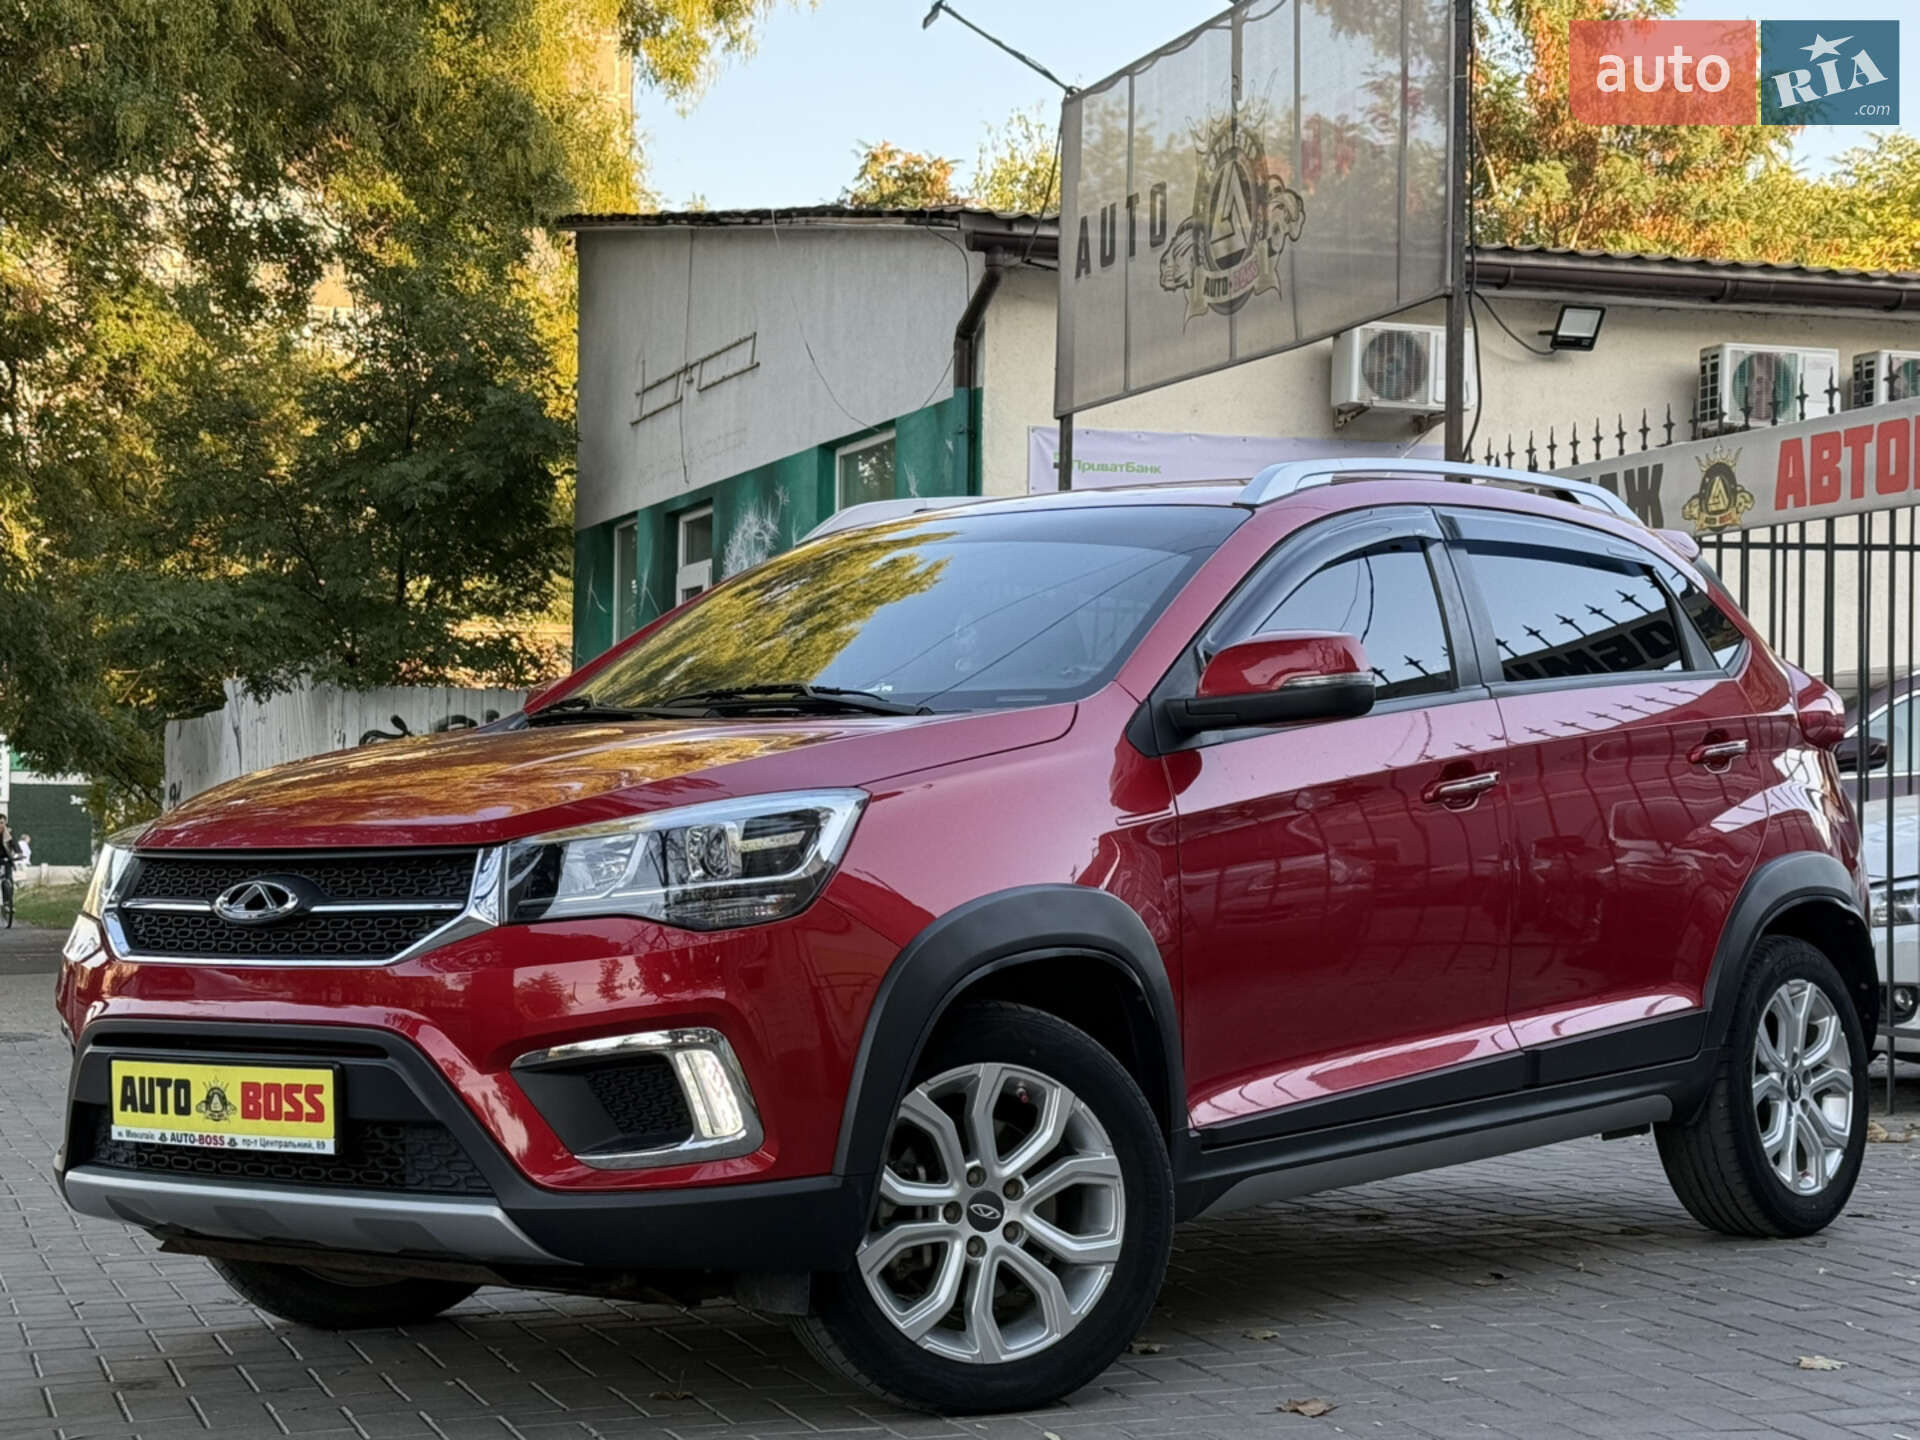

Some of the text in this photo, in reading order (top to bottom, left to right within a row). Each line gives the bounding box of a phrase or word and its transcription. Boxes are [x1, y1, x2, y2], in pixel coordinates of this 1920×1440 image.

[1075, 181, 1167, 279] AUTO
[1072, 459, 1162, 475] ПриватБанк
[1774, 414, 1920, 511] АВТО
[120, 1075, 325, 1124] AUTO BOSS
